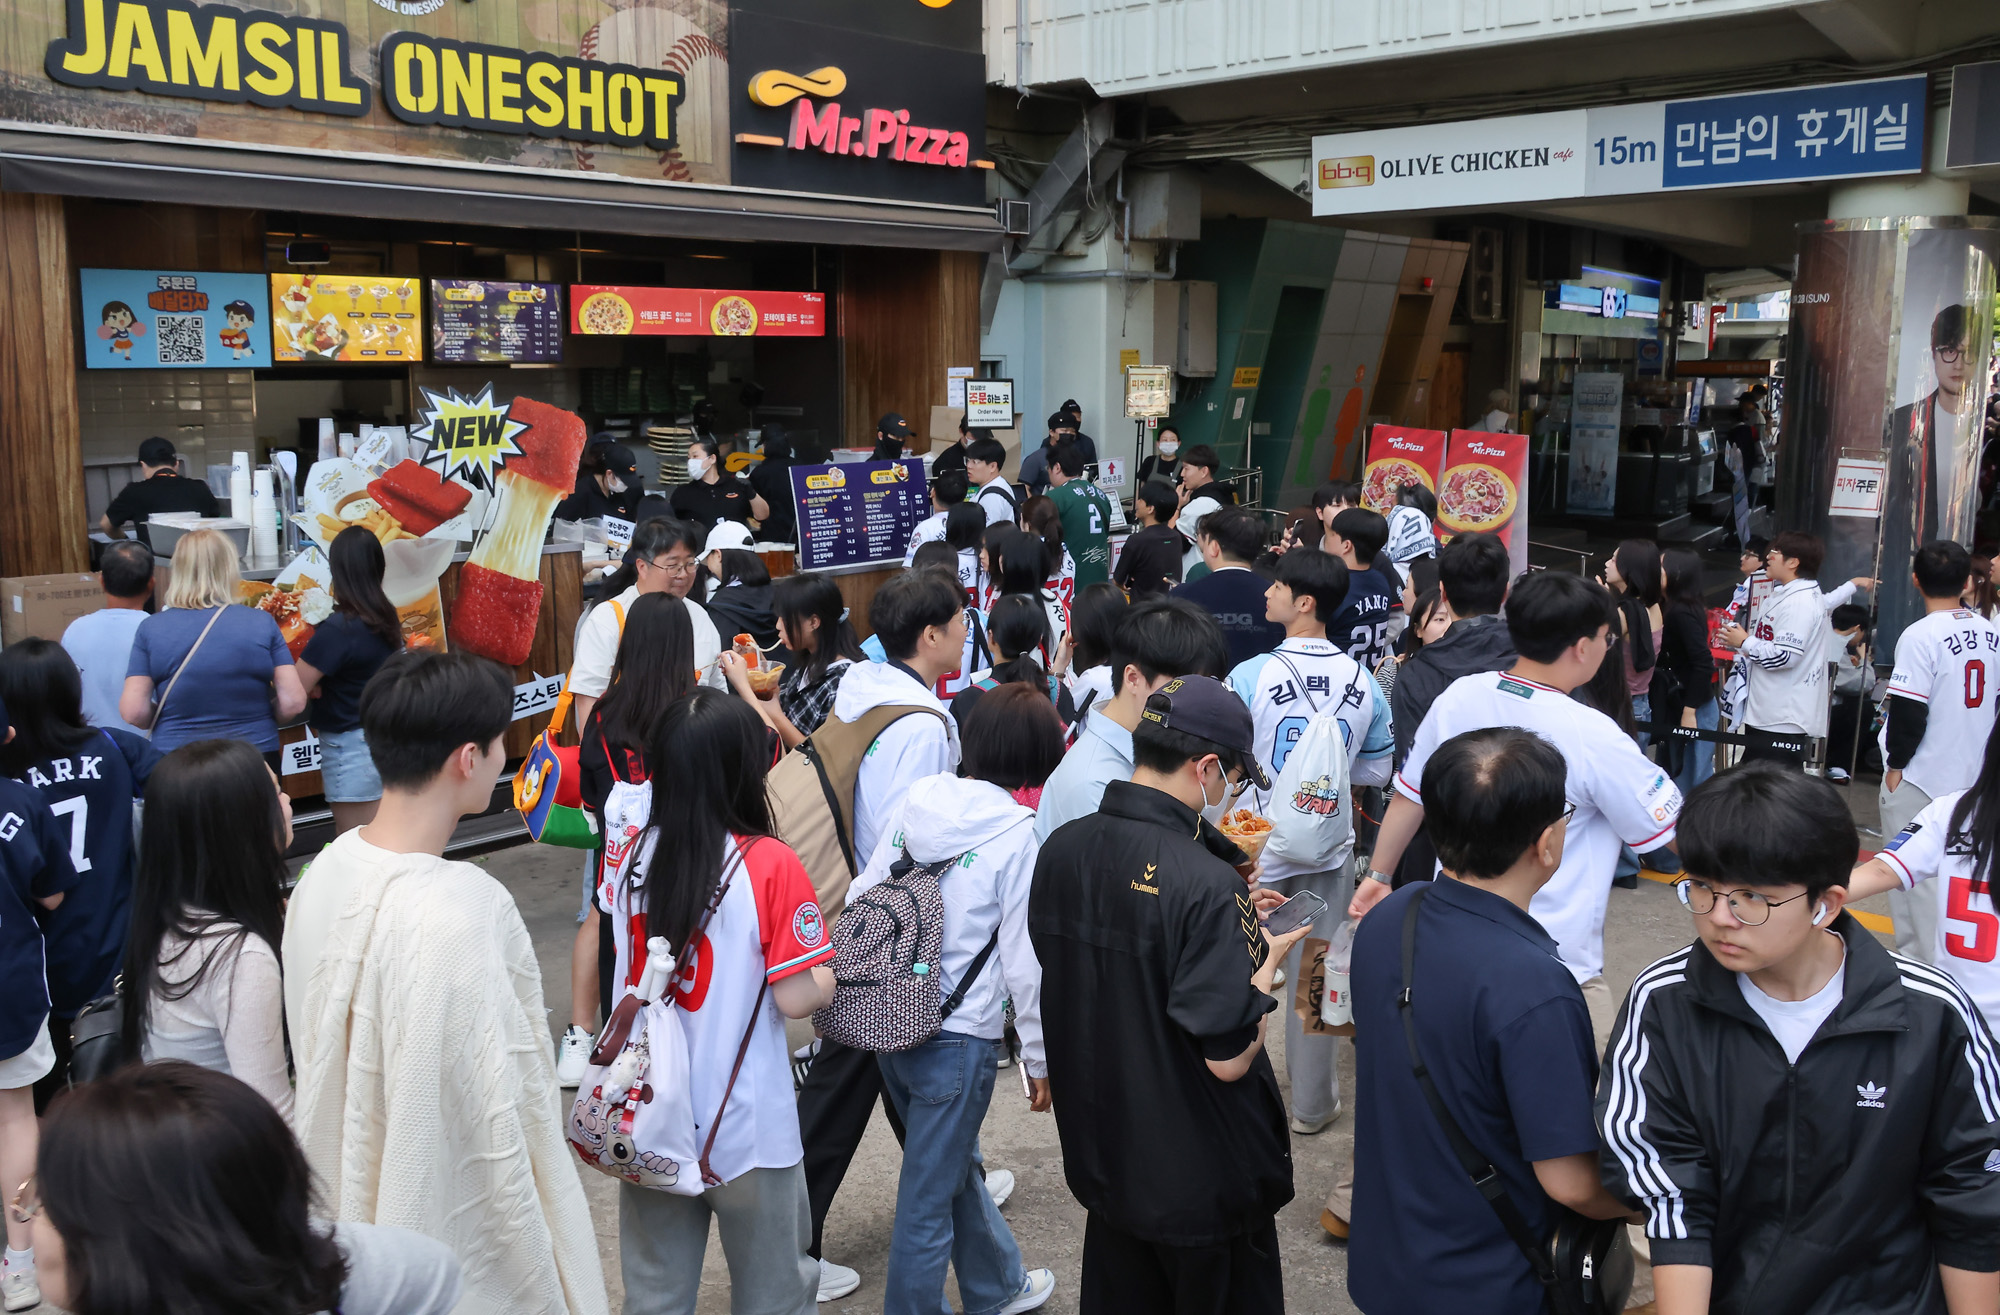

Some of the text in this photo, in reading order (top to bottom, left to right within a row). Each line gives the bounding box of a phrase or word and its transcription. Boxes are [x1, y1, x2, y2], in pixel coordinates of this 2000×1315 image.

[400, 0, 446, 16] ONESHO
[62, 0, 679, 140] JAMSIL ONESHOT
[788, 98, 969, 168] Mr.Pizza
[1675, 103, 1910, 168] 만남의 휴게실
[1593, 136, 1656, 166] 15m
[1380, 154, 1445, 178] OLIVE
[1450, 147, 1550, 173] CHICKEN
[1553, 147, 1575, 162] cafe
[158, 276, 197, 290] 주문은
[148, 290, 210, 312] 배달타자
[640, 311, 659, 320] 쉬림프
[660, 312, 672, 320] 골드
[764, 313, 786, 322] 포테이토
[787, 314, 798, 322] 골드
[969, 392, 1010, 405] 주문하는 곳
[429, 413, 509, 451] NEW
[1392, 441, 1425, 452] Mr.Pizza
[1472, 447, 1506, 458] Mr.Pizza
[1837, 478, 1878, 494] 피자주문
[1088, 503, 1103, 534] 2
[1355, 594, 1389, 616] YANG
[1943, 629, 2000, 656] 김강민
[1268, 675, 1366, 710] 김택연
[1964, 659, 1986, 709] 0
[1672, 728, 1700, 739] AMOJE
[1771, 741, 1801, 752] AMOJE
[12, 756, 103, 789] ARK
[49, 794, 93, 874] 7
[1130, 879, 1159, 896] hummel
[1856, 1100, 1886, 1109] adidas
